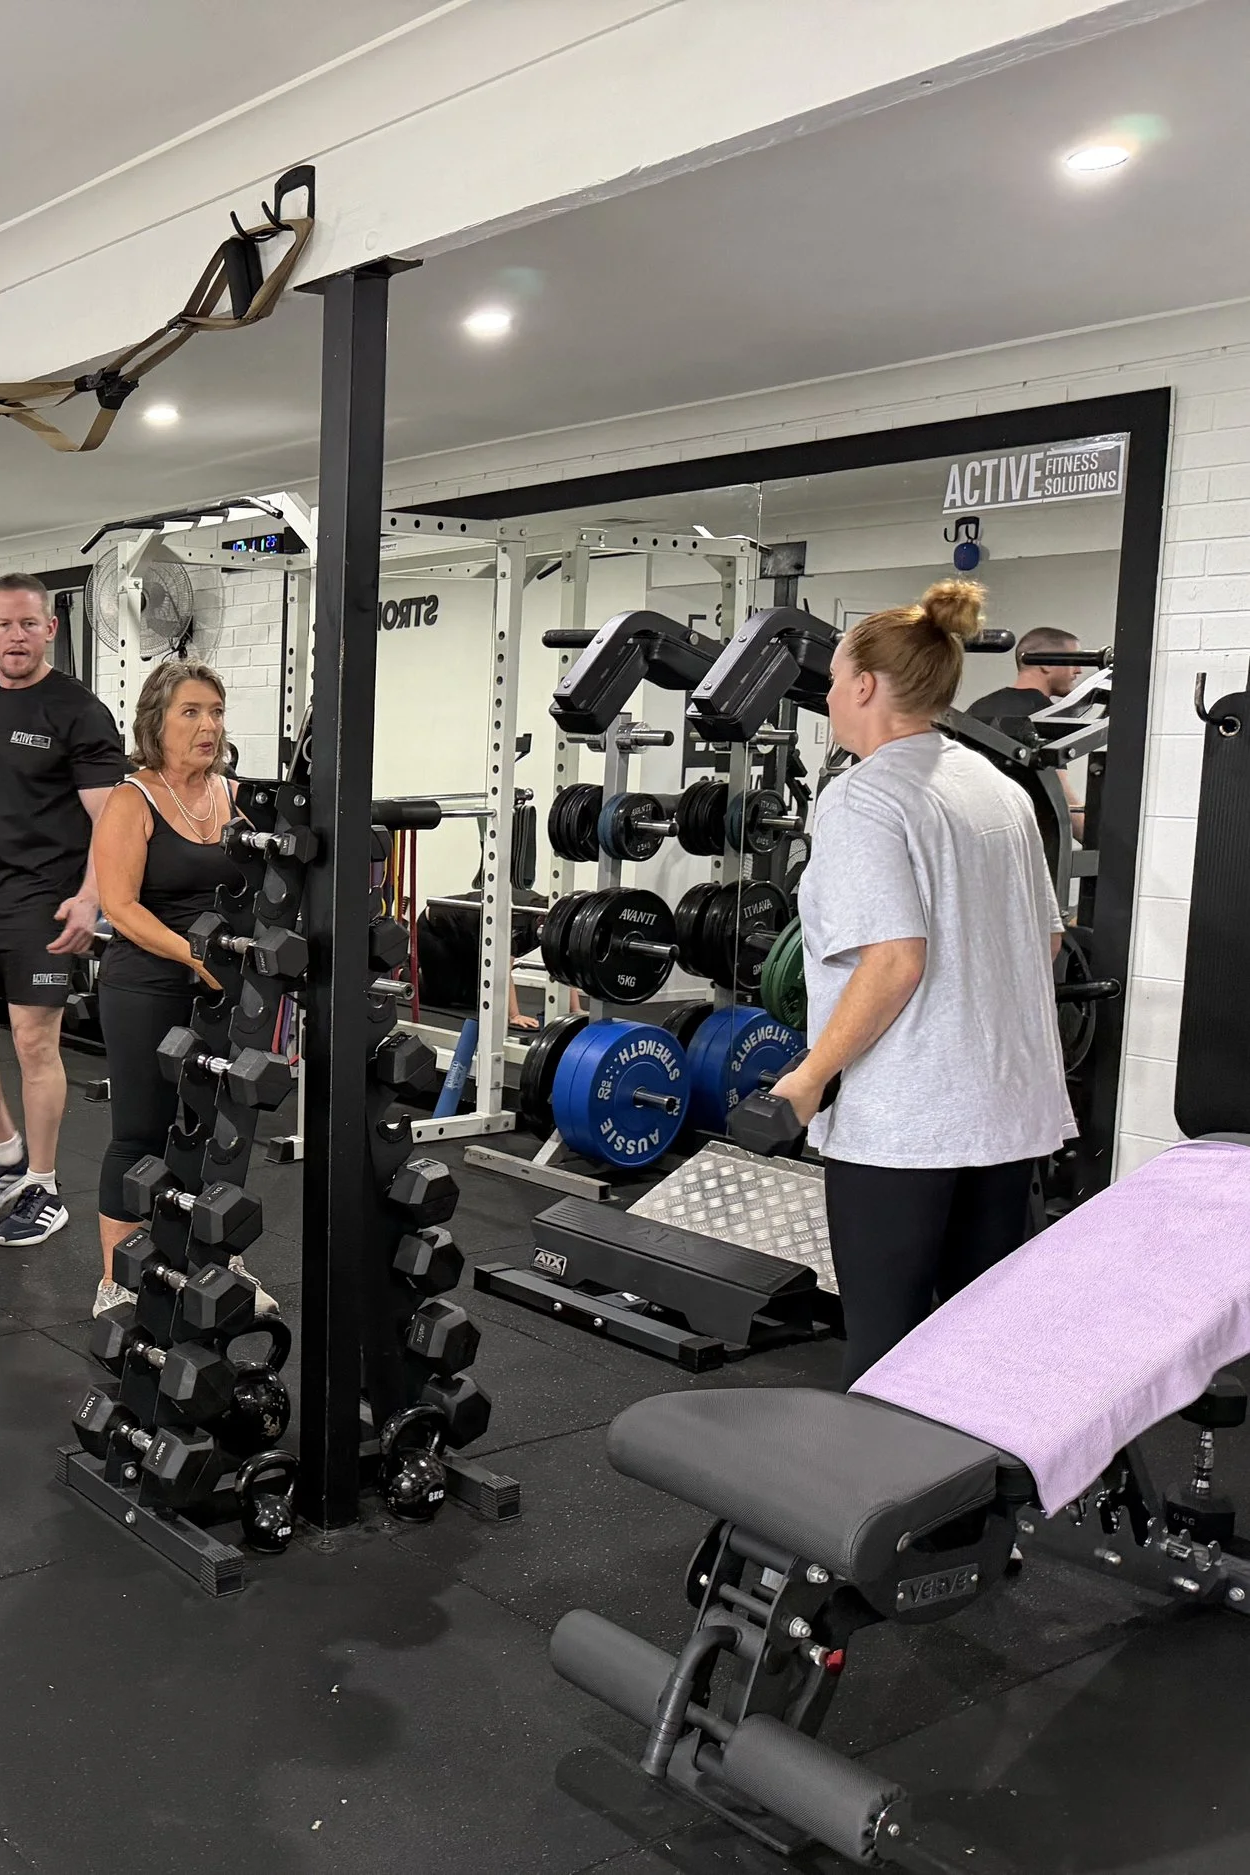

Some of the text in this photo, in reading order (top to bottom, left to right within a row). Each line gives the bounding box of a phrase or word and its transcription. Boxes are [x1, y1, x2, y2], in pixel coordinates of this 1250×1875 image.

[1045, 451, 1099, 476] FITNESS
[943, 451, 1044, 508] ACTIVE
[1044, 470, 1117, 496] SOLUTIONS
[618, 907, 658, 928] AVANTI
[617, 972, 637, 989] 15KG
[618, 1038, 680, 1081] STRENGTH
[597, 1086, 612, 1100] 20
[599, 1117, 661, 1155] AUSSIE
[534, 1251, 564, 1270] ATX
[81, 1395, 96, 1419] 10KG
